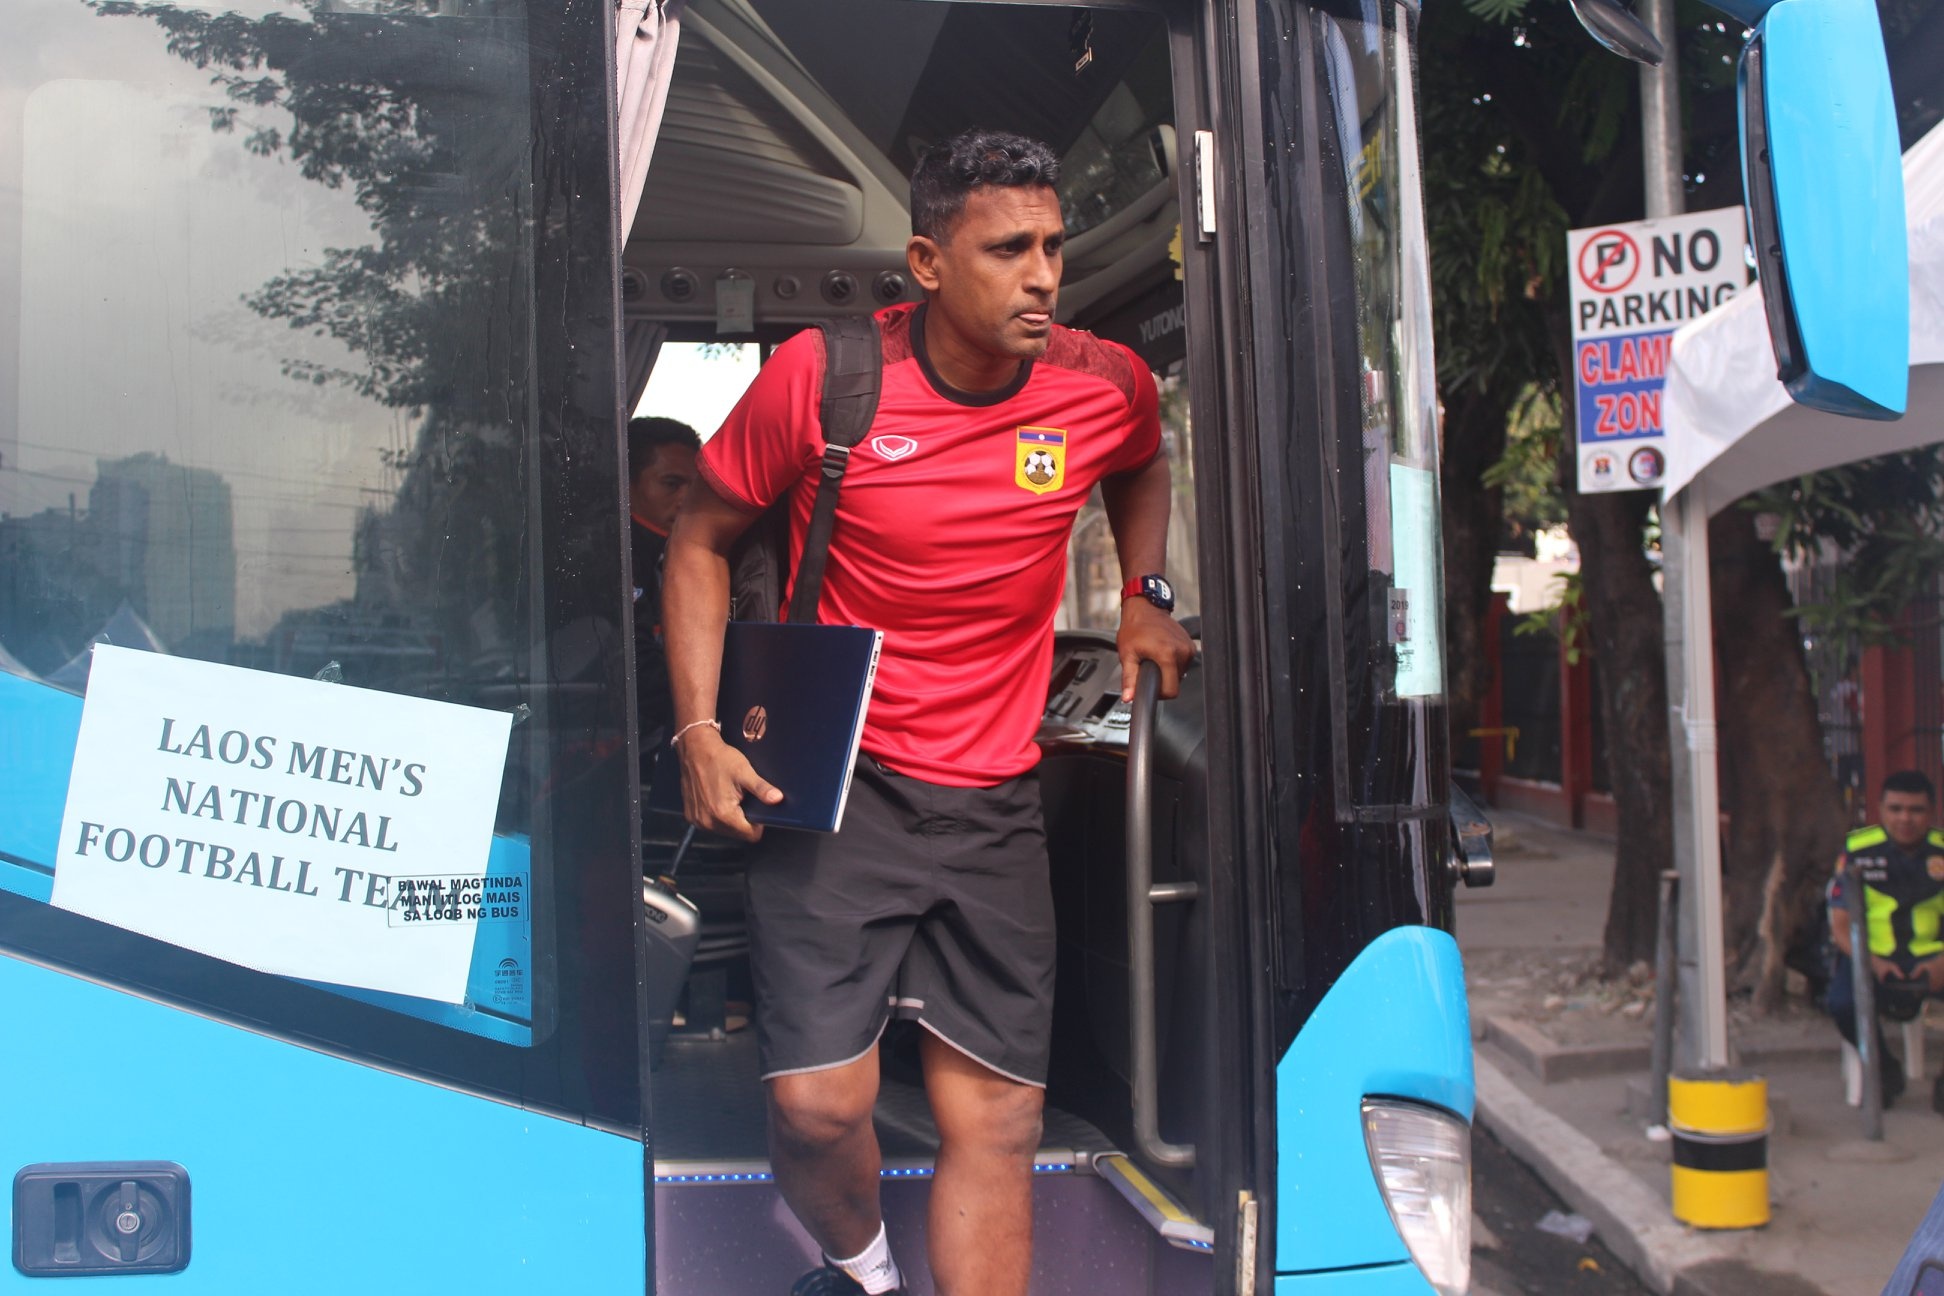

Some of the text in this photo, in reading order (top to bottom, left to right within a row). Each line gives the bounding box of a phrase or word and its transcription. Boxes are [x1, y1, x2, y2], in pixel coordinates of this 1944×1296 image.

[1653, 228, 1721, 278] NO
[1579, 283, 1737, 331] PARKING
[1391, 600, 1409, 610] 2019
[157, 717, 426, 797] LAOS MEN'S
[161, 777, 399, 852] NATIONAL
[75, 821, 464, 921] FOOTBALL TEAM
[398, 876, 523, 892] BAWAL MAGTINDA
[403, 906, 519, 921] SA LOOB NG BUS
[441, 893, 482, 905] ITLOG
[486, 892, 520, 904] MAIS
